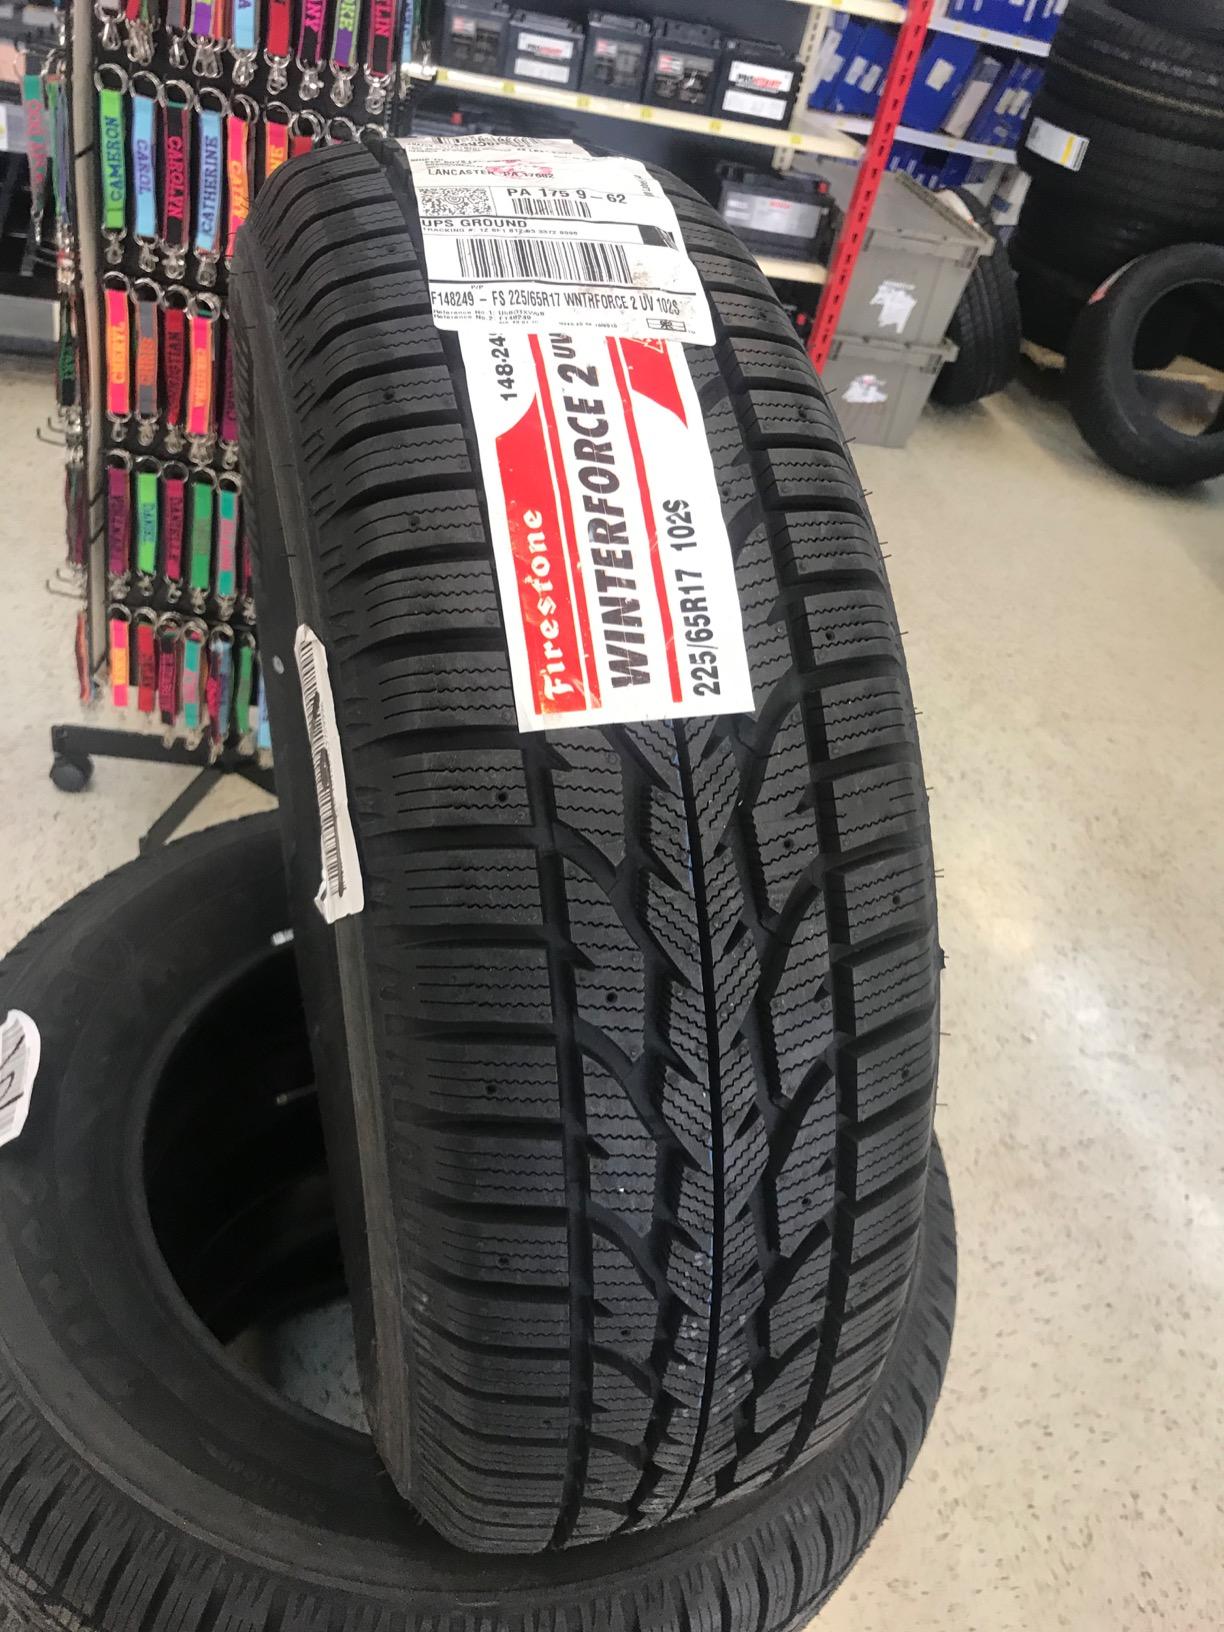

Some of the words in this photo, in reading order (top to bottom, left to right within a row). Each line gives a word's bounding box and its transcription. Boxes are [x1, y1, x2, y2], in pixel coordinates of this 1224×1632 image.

[108, 116, 123, 201] CAMERON
[138, 140, 153, 195] CAROL
[167, 136, 185, 219] CAROLYN
[200, 135, 219, 233] CATHERINE
[428, 168, 496, 177] LANCASTER
[506, 188, 532, 197] PA
[421, 219, 455, 228] UPS
[460, 218, 528, 228] GROUND
[431, 291, 475, 307] F148249
[491, 290, 506, 307] FS
[508, 289, 560, 308] 225/65R17
[563, 292, 629, 311] WNTRFORCE
[630, 296, 638, 311] 2
[639, 294, 655, 312] UV
[656, 297, 681, 316] 102S
[557, 364, 600, 388] 2
[562, 396, 651, 689] WINTERFORCE
[663, 499, 697, 552] 102S
[523, 507, 574, 702] Firestone
[674, 568, 721, 697] 225/65R17
